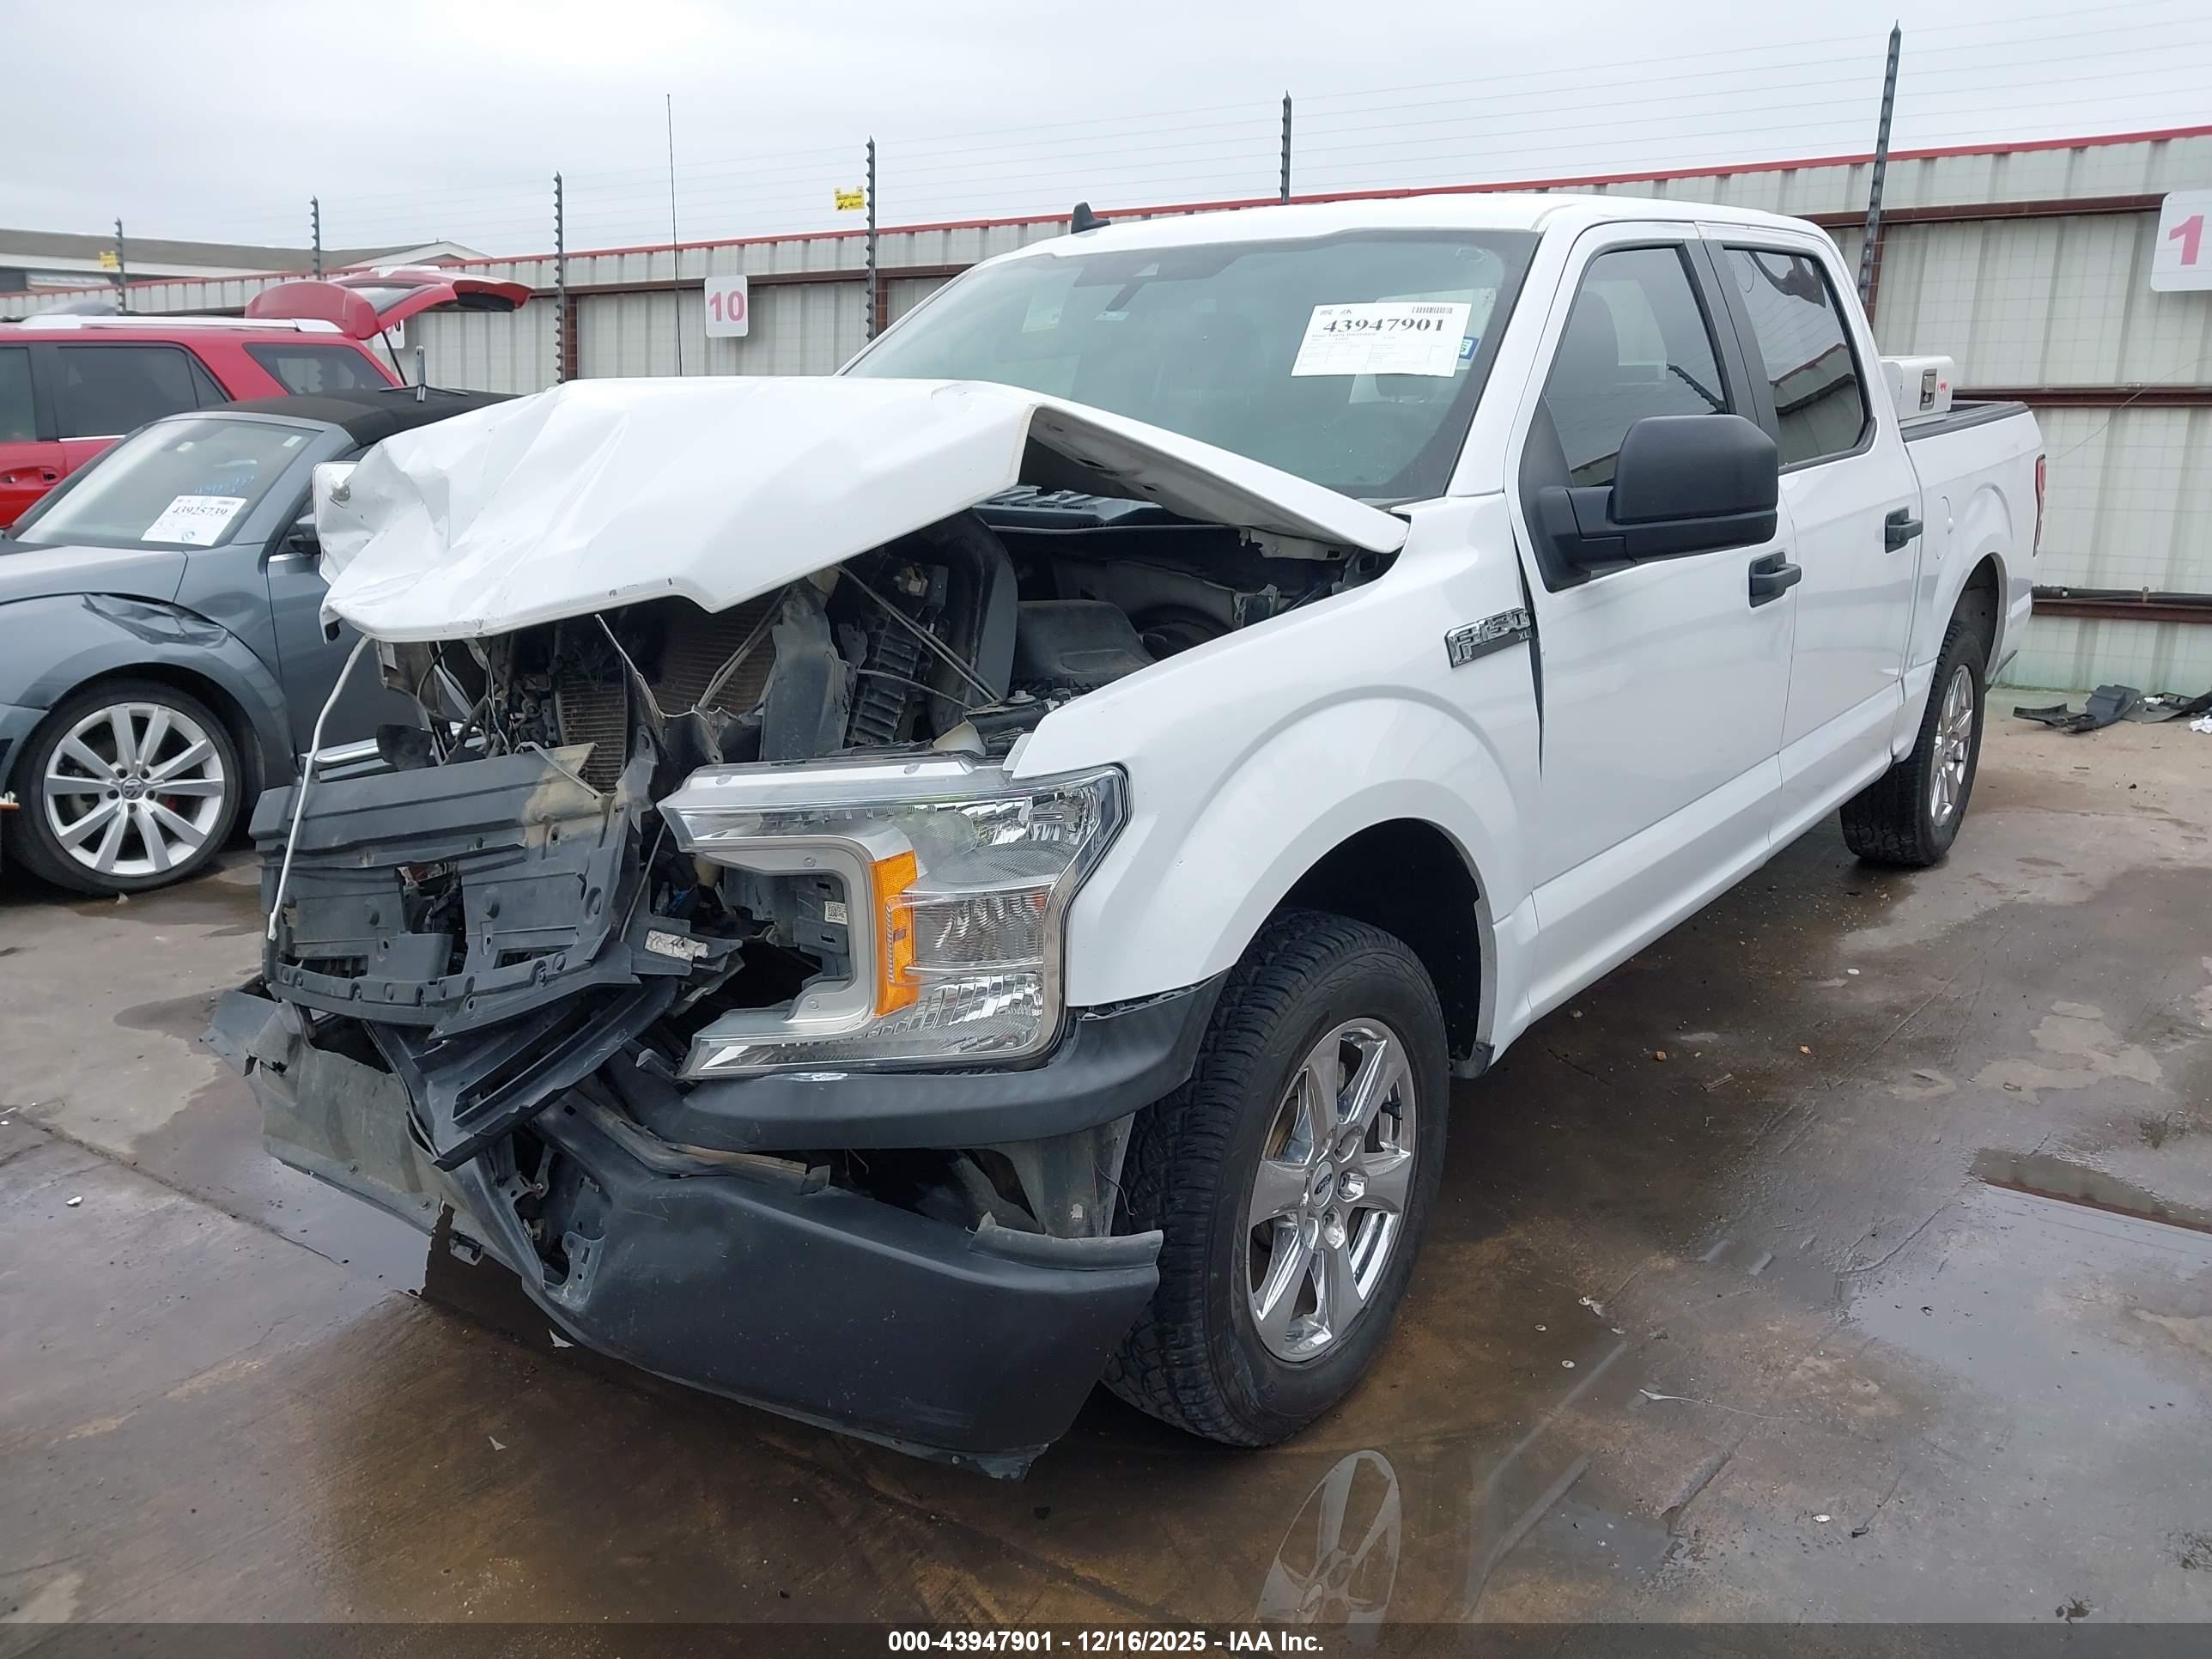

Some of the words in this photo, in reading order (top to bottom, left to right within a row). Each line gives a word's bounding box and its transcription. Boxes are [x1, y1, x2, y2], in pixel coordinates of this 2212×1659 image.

[2169, 215, 2204, 265] 1
[709, 290, 744, 321] 10
[1322, 318, 1443, 332] 43947901
[173, 506, 228, 516] 43925739
[1517, 631, 1529, 641] XL
